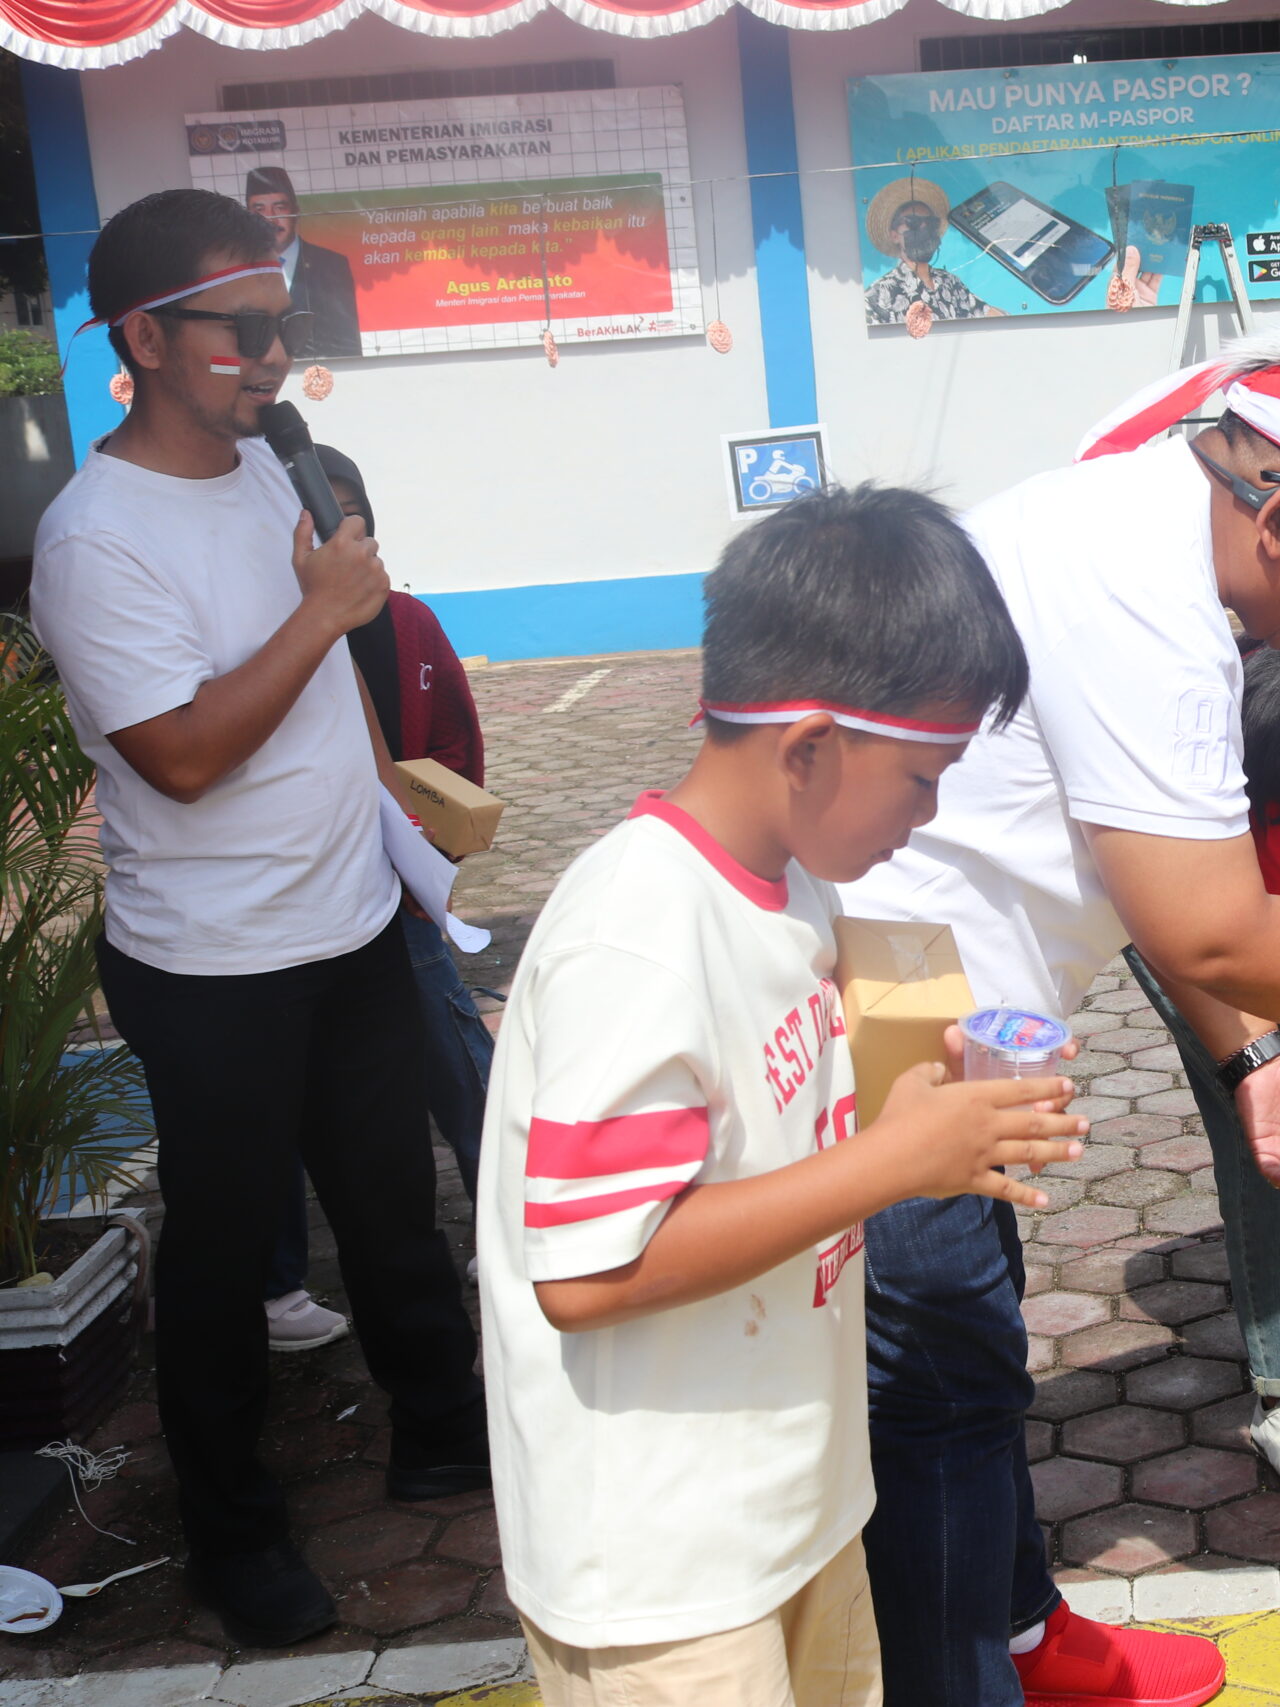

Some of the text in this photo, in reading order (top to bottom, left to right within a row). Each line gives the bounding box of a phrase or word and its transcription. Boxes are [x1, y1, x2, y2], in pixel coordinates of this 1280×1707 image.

[930, 86, 996, 112] MAU
[1005, 82, 1105, 108] PUNYA
[1113, 74, 1230, 102] PASPOR
[240, 127, 280, 137] IMIGRASI
[339, 118, 553, 145] KEMENTERIAN IMIGRASI
[992, 107, 1194, 134] DAFTAR M-PASPOR
[344, 140, 551, 166] DAN PEMASYARAKATAN
[906, 145, 975, 159] APLIKASI
[1170, 133, 1233, 146] PASPOR
[432, 204, 485, 223] apabila
[490, 200, 518, 216] kita
[582, 195, 614, 210] baik
[361, 227, 416, 246] kepada
[420, 228, 466, 244] orang
[554, 216, 623, 233] kebaikan
[627, 214, 646, 228] itu
[363, 250, 400, 265] akan
[405, 244, 466, 263] kembali
[470, 241, 526, 259] kepada
[435, 290, 586, 308] Menteri Imigrasi dan Pemasarakatan
[446, 275, 573, 297] Agus Ardianto
[577, 324, 641, 338] BerAKHLAK
[737, 448, 758, 473] P
[409, 780, 445, 808] LOMBA
